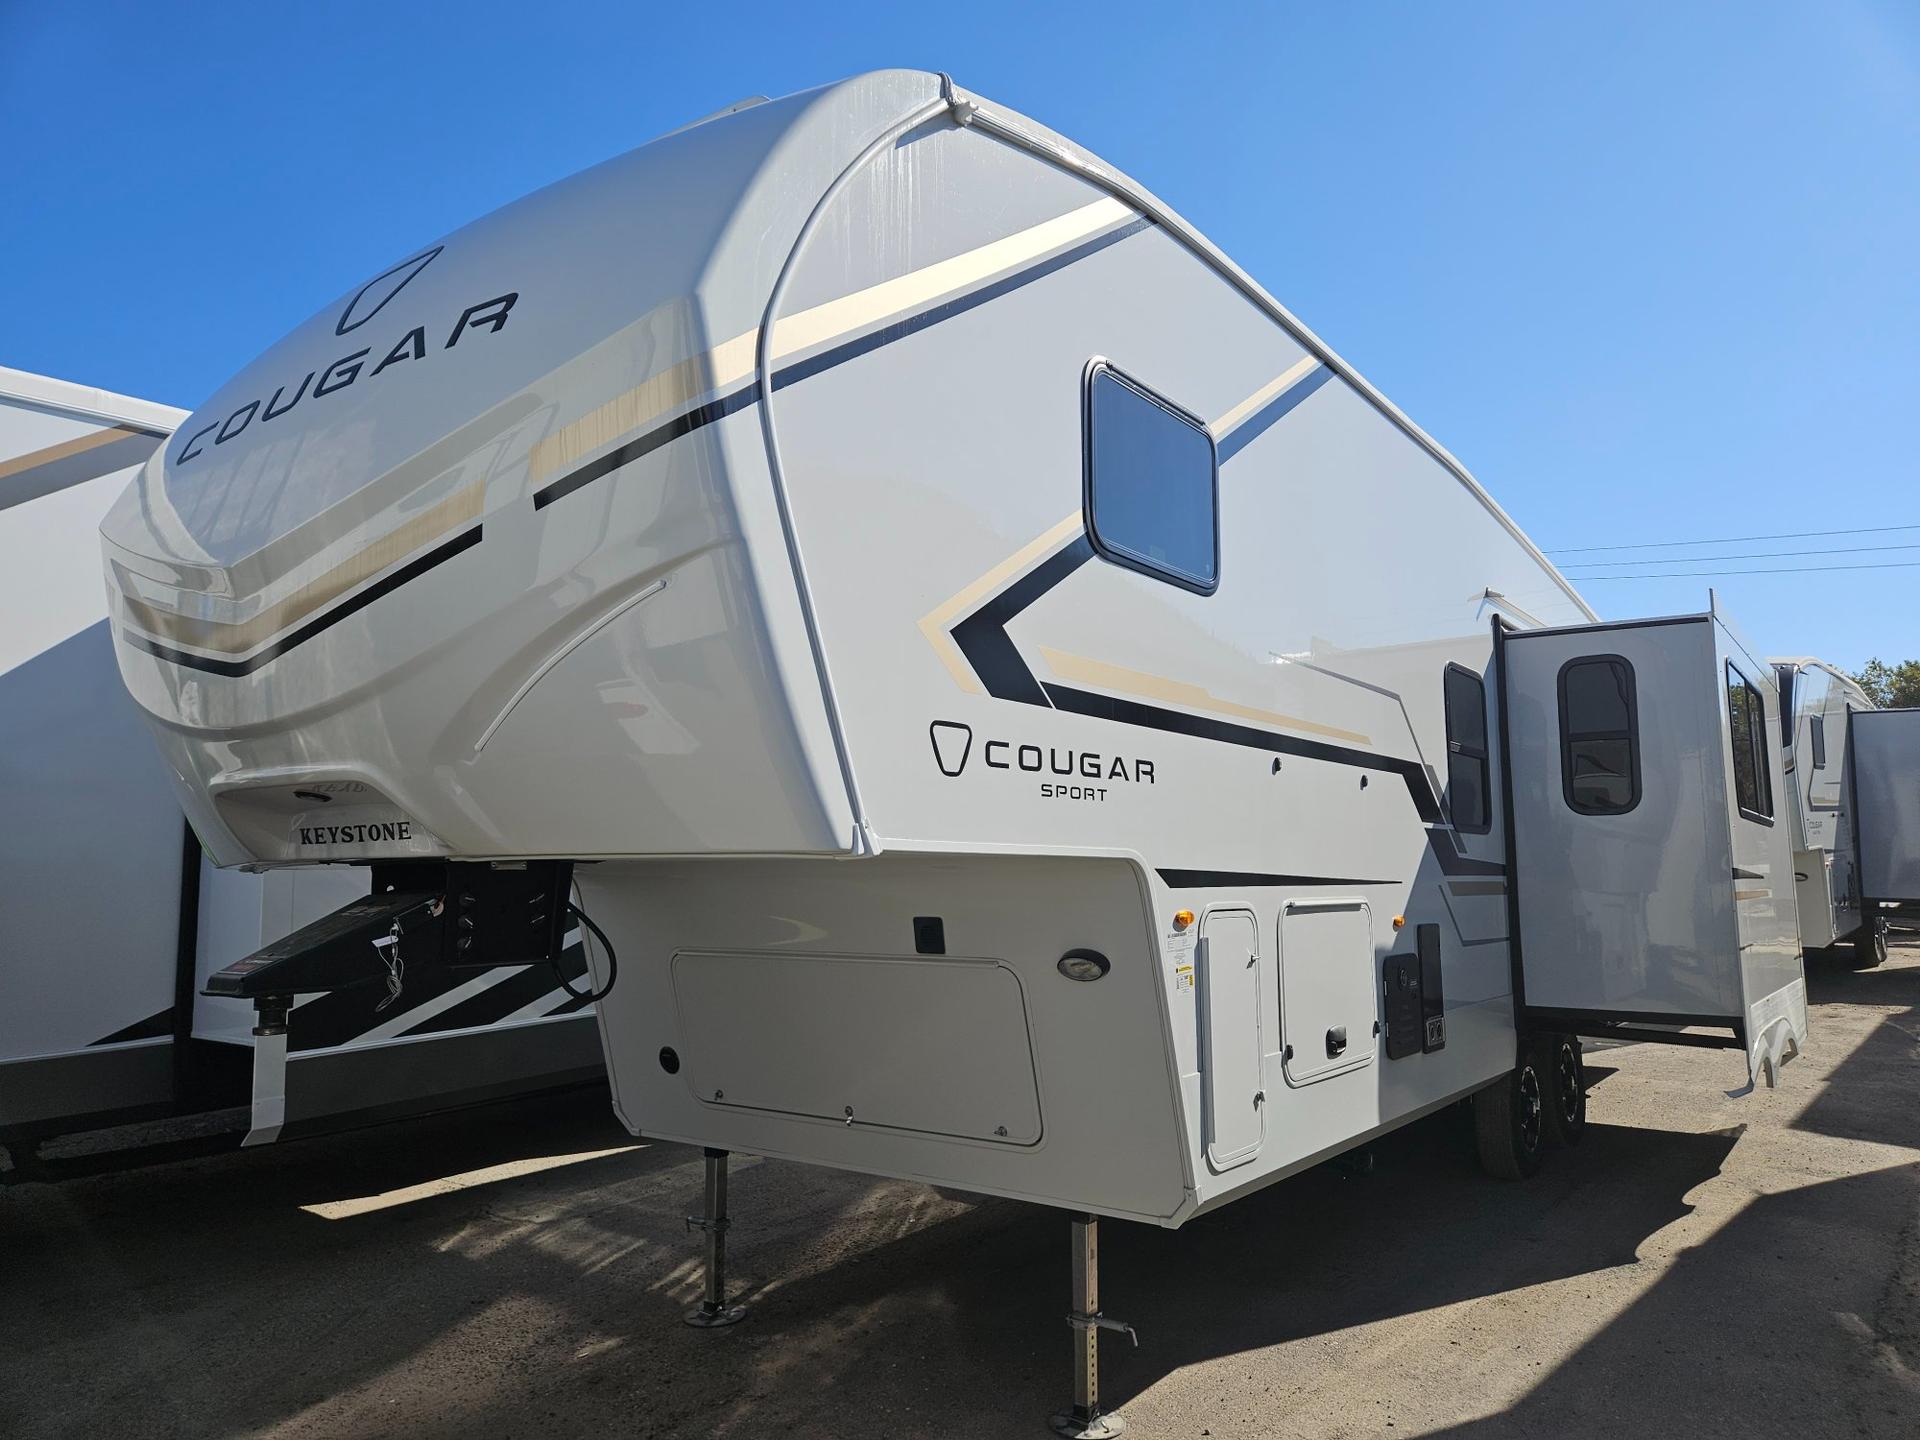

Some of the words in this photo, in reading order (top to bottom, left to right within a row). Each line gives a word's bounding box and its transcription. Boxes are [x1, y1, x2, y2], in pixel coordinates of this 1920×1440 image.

[176, 292, 519, 466] COUGAR
[985, 740, 1155, 784] COUGAR
[1041, 784, 1108, 801] SPORT
[300, 822, 412, 845] KEYSTONE
